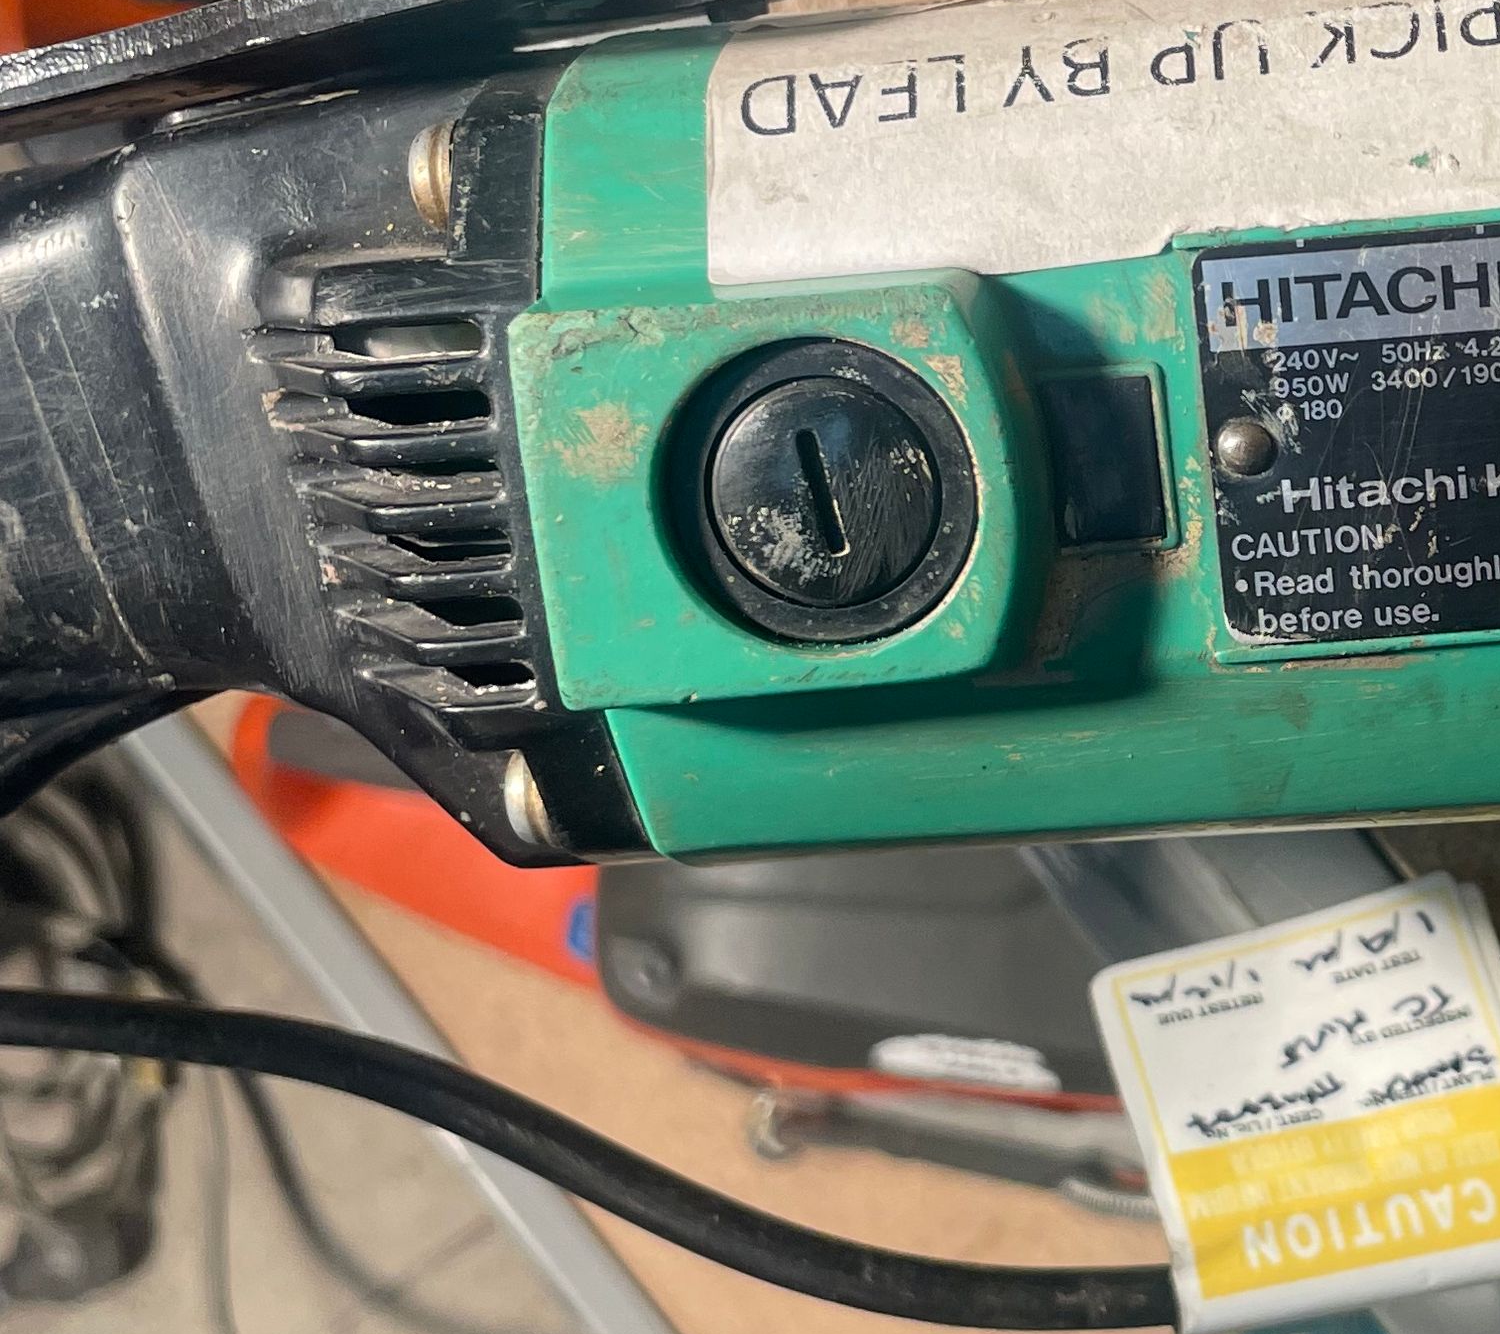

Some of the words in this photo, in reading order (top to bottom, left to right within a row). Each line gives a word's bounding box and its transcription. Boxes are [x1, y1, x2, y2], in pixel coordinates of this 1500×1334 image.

[1149, 18, 1270, 88] UP
[1007, 36, 1111, 108] BY
[739, 51, 967, 136] LEAD
[1381, 341, 1446, 365] 50Hz
[1274, 371, 1349, 400] 950W
[1281, 465, 1469, 514] Hitachi
[1230, 523, 1385, 562] CAUTION
[1254, 566, 1335, 598] Read
[1257, 605, 1363, 635] before
[1374, 602, 1440, 627] use.
[1333, 962, 1377, 985] DATE
[1378, 949, 1423, 974] TEST
[1158, 1007, 1194, 1026] DUE
[1198, 990, 1264, 1018] RETEST
[1242, 1175, 1498, 1271] CAUTION
